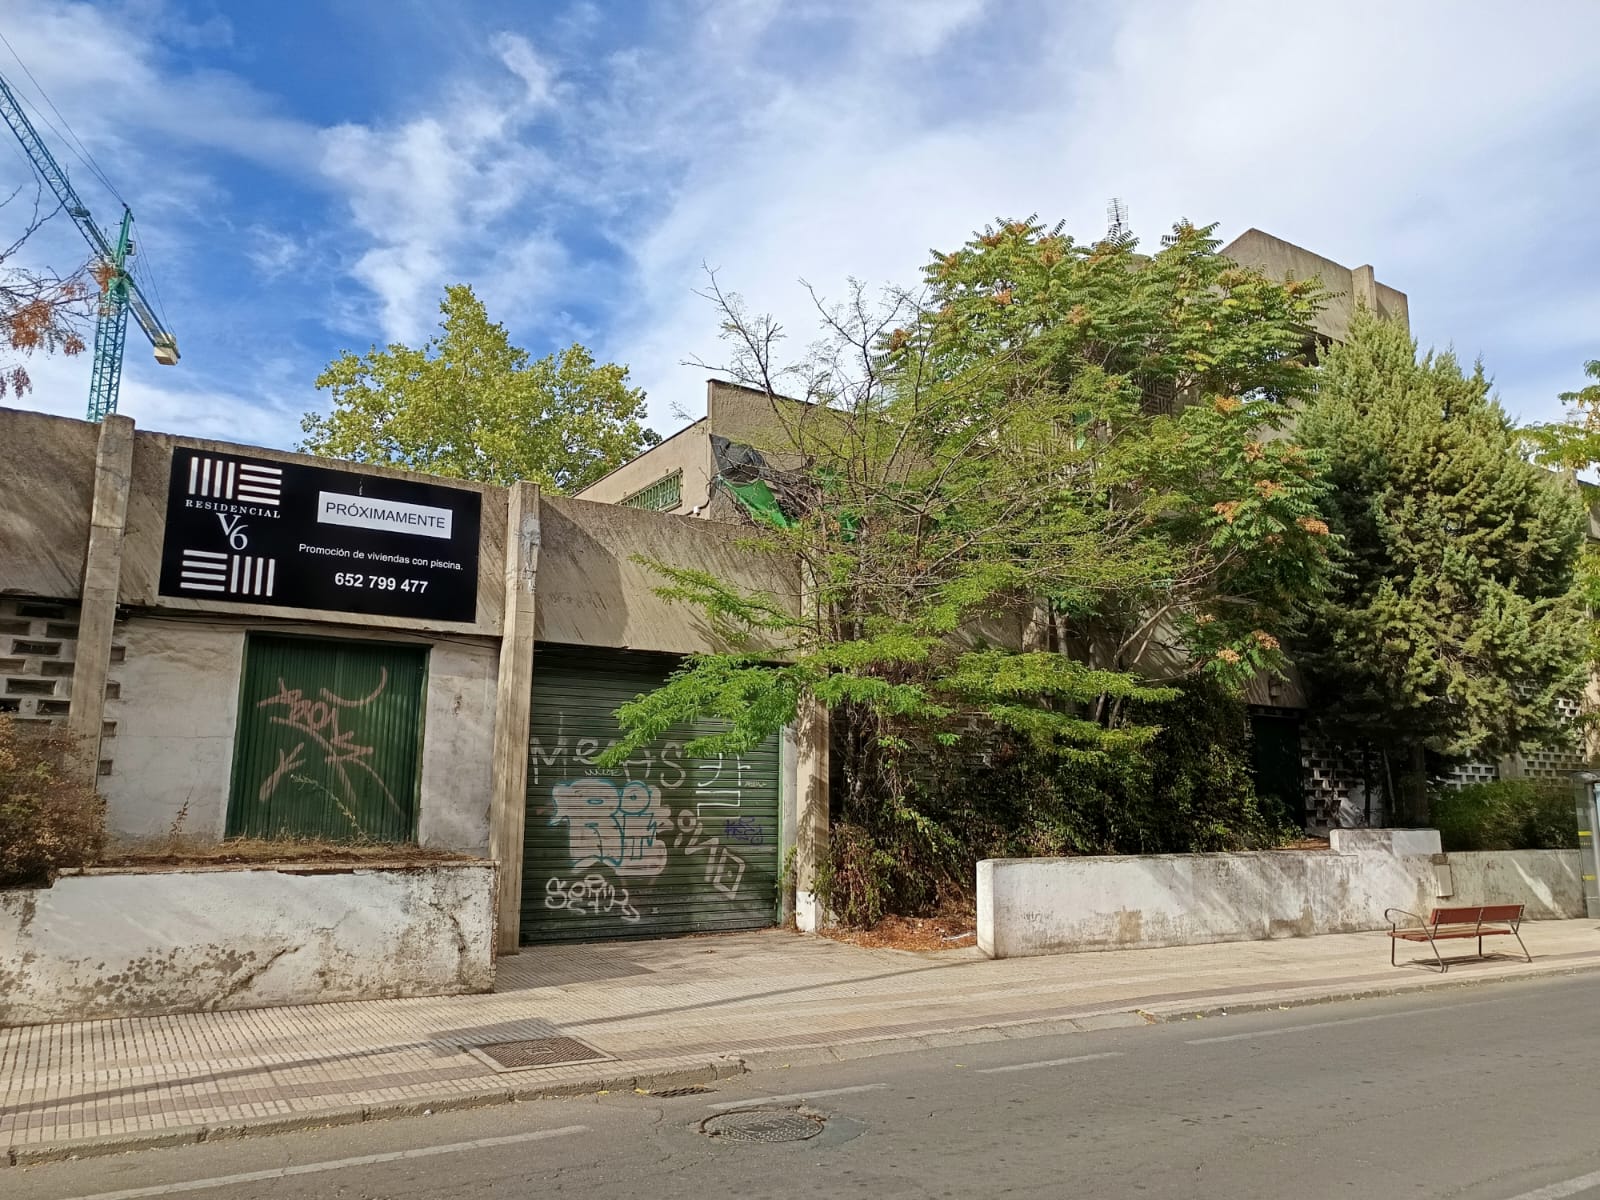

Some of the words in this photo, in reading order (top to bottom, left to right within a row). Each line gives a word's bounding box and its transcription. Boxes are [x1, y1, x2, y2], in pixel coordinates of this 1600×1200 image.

[185, 499, 281, 519] RESIDENCIAL
[325, 501, 446, 529] PRÓXIMAMENTE
[216, 512, 249, 551] V6
[299, 543, 351, 559] Promoción
[352, 549, 365, 560] de
[367, 550, 410, 565] viviendas
[411, 556, 428, 567] con
[430, 557, 464, 571] piscina.
[334, 571, 364, 588] 652
[368, 574, 397, 591] 799
[400, 577, 429, 594] 477
